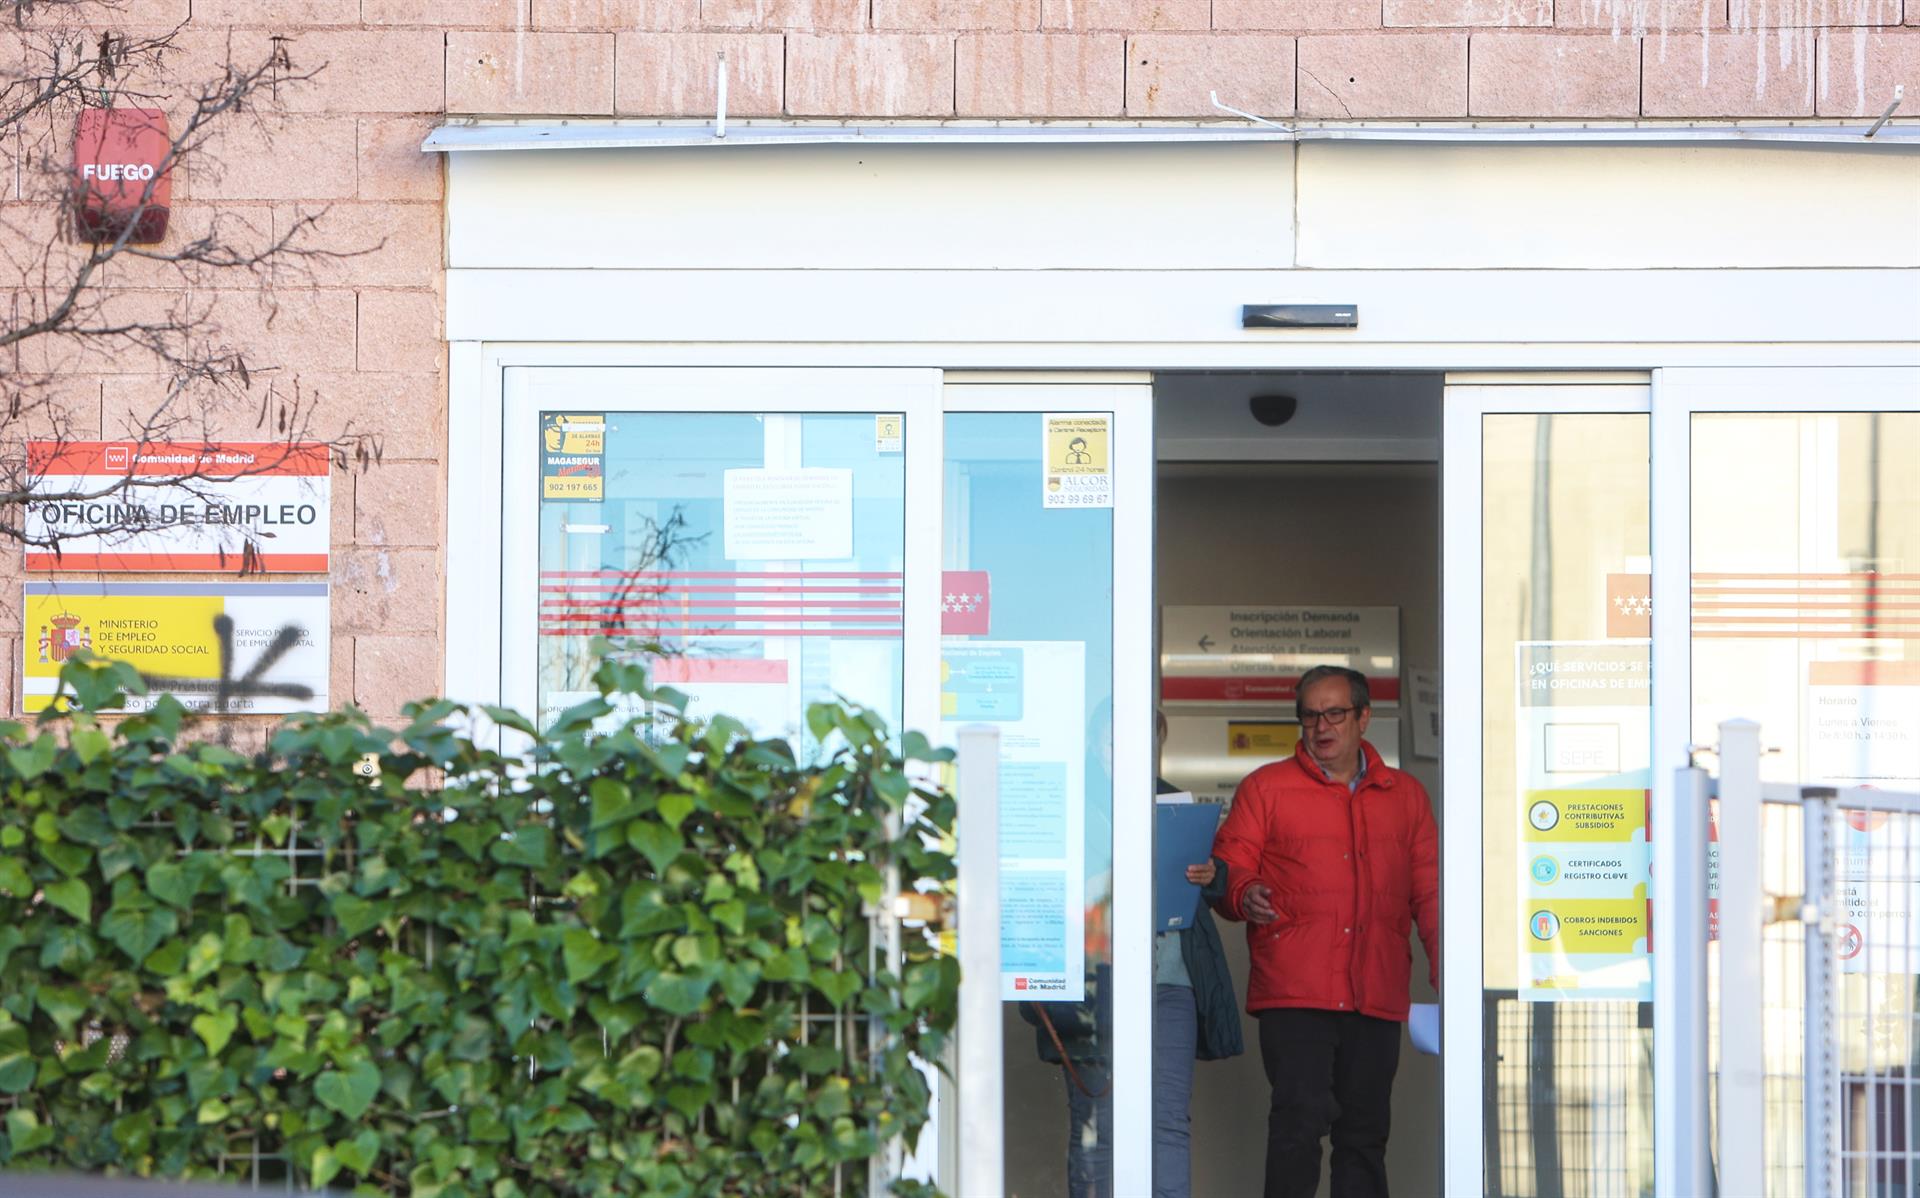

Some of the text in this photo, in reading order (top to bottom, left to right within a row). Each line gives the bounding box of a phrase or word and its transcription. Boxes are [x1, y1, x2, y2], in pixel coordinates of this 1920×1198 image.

[83, 164, 154, 181] FUEGO
[132, 454, 195, 464] Comunidad
[216, 453, 255, 464] Madrid
[1064, 476, 1108, 486] ALCOR
[549, 483, 564, 491] 902
[566, 483, 581, 491] 197
[1048, 494, 1065, 504] 902
[1068, 494, 1080, 504] 99
[41, 504, 317, 525] OFICINA DE EMPLEO
[1230, 611, 1360, 624] Inscripción Demanda
[99, 620, 158, 629] MINISTERIO
[99, 632, 156, 641] DE EMPLEO
[236, 629, 272, 637] SERVICIO
[1230, 627, 1352, 638] Orientación Laboral
[99, 644, 209, 654] Y SEGURIDAD SOCIAL
[1562, 661, 1626, 672] SERVICIOS
[1629, 661, 1643, 672] SE
[1531, 679, 1547, 689] EN
[1550, 679, 1607, 690] OFICINAS
[1610, 679, 1625, 689] DE
[1818, 696, 1858, 705] Horario
[1559, 750, 1605, 765] SEPE
[1567, 803, 1624, 811] PRESTACIONES
[1564, 812, 1625, 820] CONTRIBUTIVAS
[1575, 821, 1615, 829] SUBSIDIOS
[1564, 872, 1628, 880] REGISTRO CL@VE
[1564, 916, 1638, 924] COBROS INDEBIDOS
[1578, 929, 1623, 937] SANCIONES
